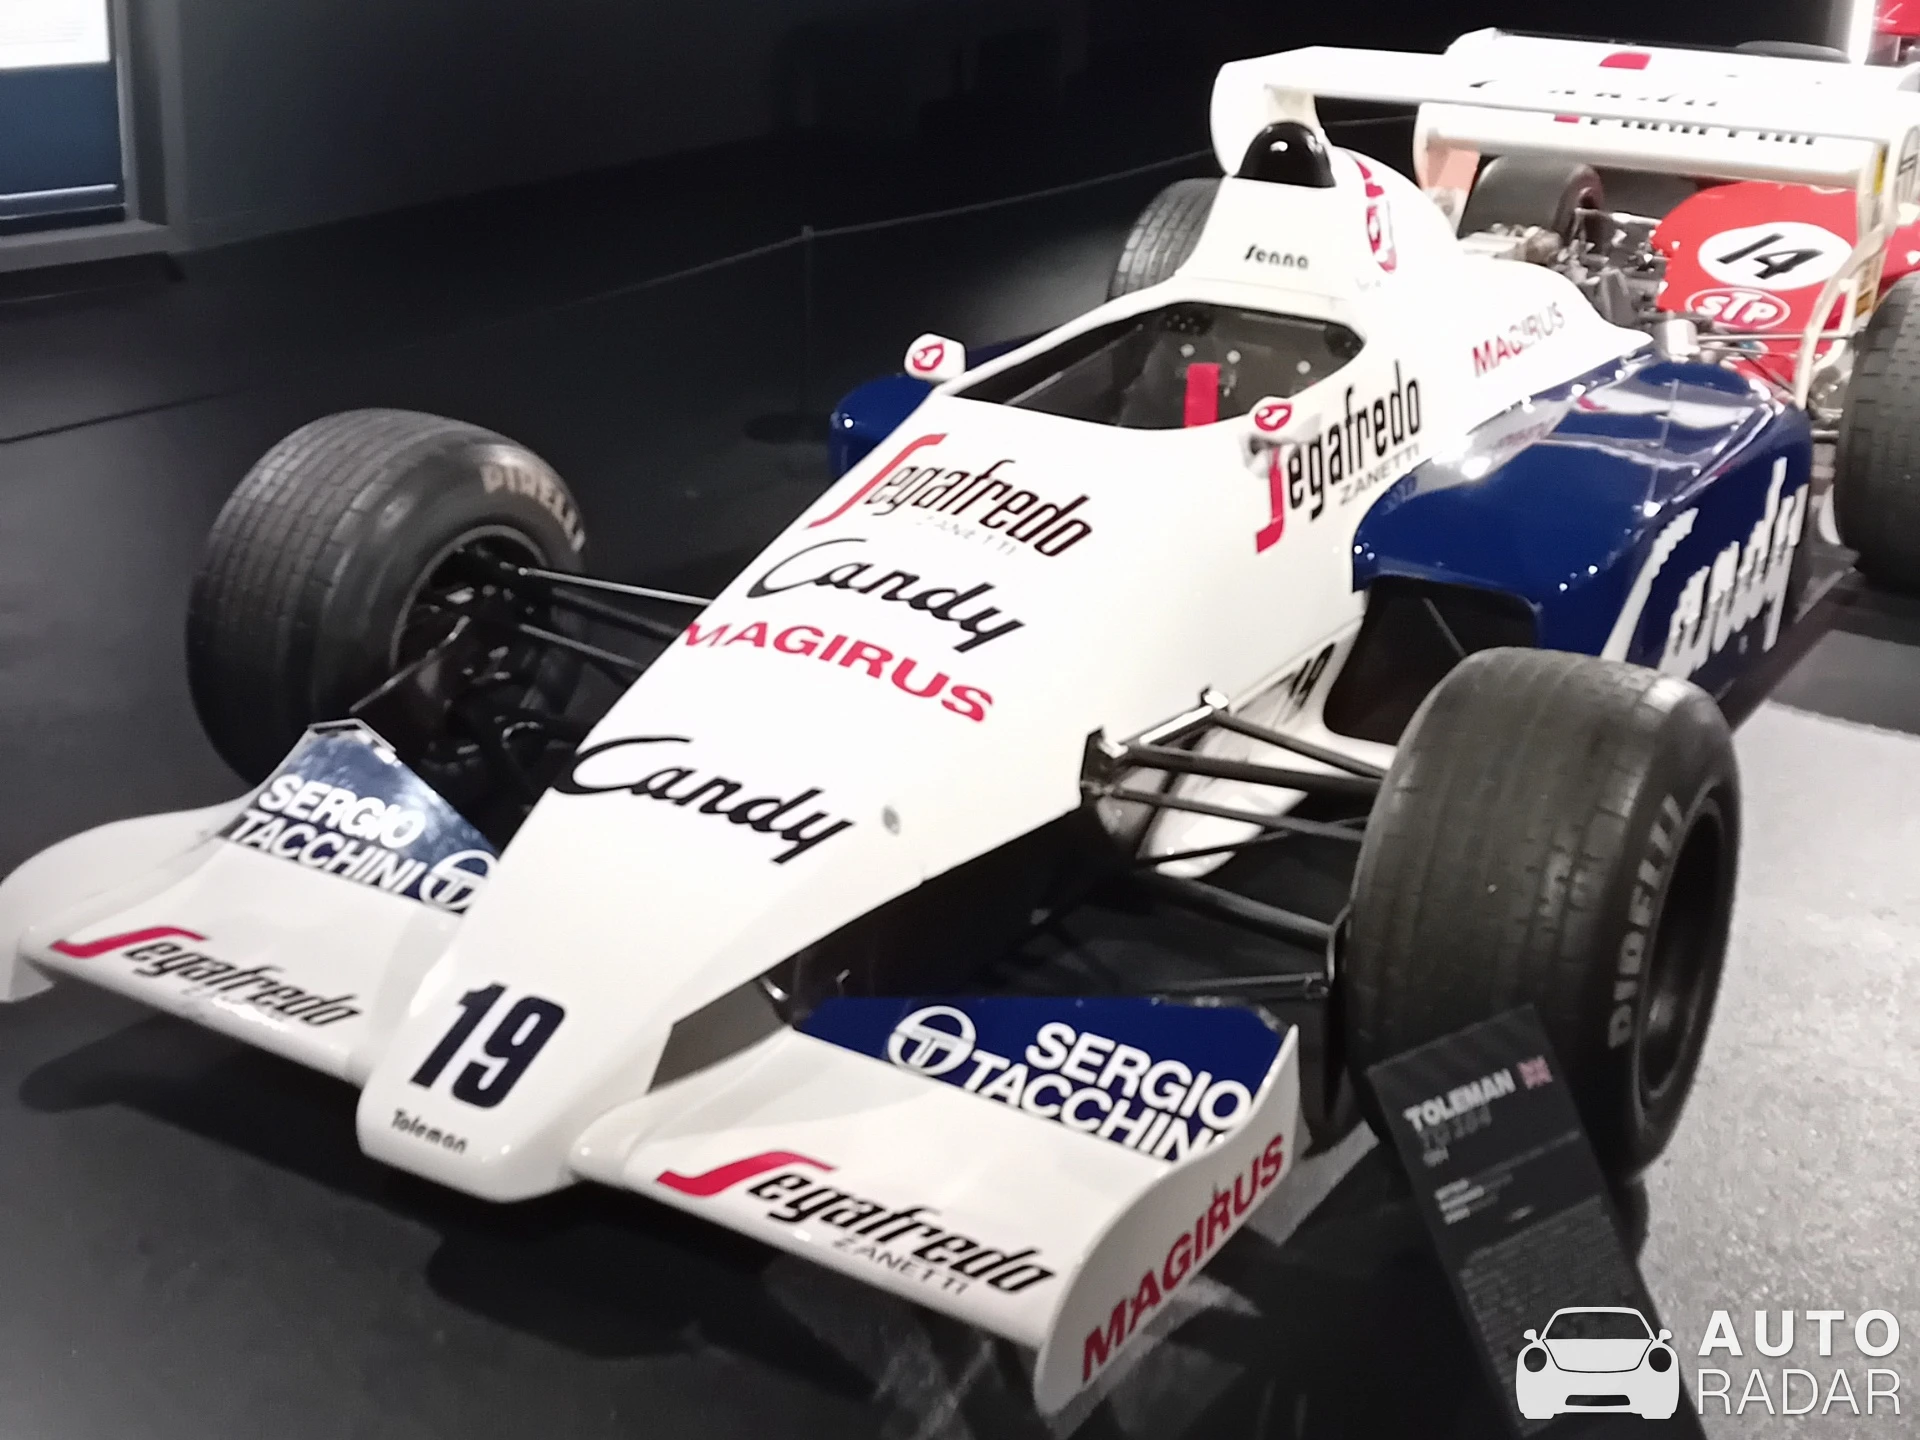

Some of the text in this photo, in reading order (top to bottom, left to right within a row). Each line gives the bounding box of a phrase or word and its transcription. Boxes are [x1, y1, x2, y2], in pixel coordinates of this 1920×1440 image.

[1244, 244, 1310, 270] Senna
[1696, 291, 1779, 324] STP
[1716, 232, 1825, 280] 14
[803, 432, 1094, 557] Segafredo
[1256, 359, 1421, 554] Segafredo
[746, 537, 1026, 653] Candy
[684, 620, 994, 724] MAGIRUS
[257, 774, 427, 850] SERGIO
[552, 735, 856, 866] Candy
[228, 810, 426, 896] TACCHINI
[48, 925, 363, 1027] Segafredo
[409, 982, 566, 1109] 19
[1025, 1022, 1254, 1131] SERGIO
[391, 1109, 469, 1154] Toleman
[962, 1048, 1215, 1165] TACCHIN
[1402, 1067, 1518, 1133] TOLEMAN
[655, 1149, 1058, 1294] Segafredo
[831, 1236, 972, 1296] ZANETTI
[1081, 1132, 1286, 1382] MAGIRUS
